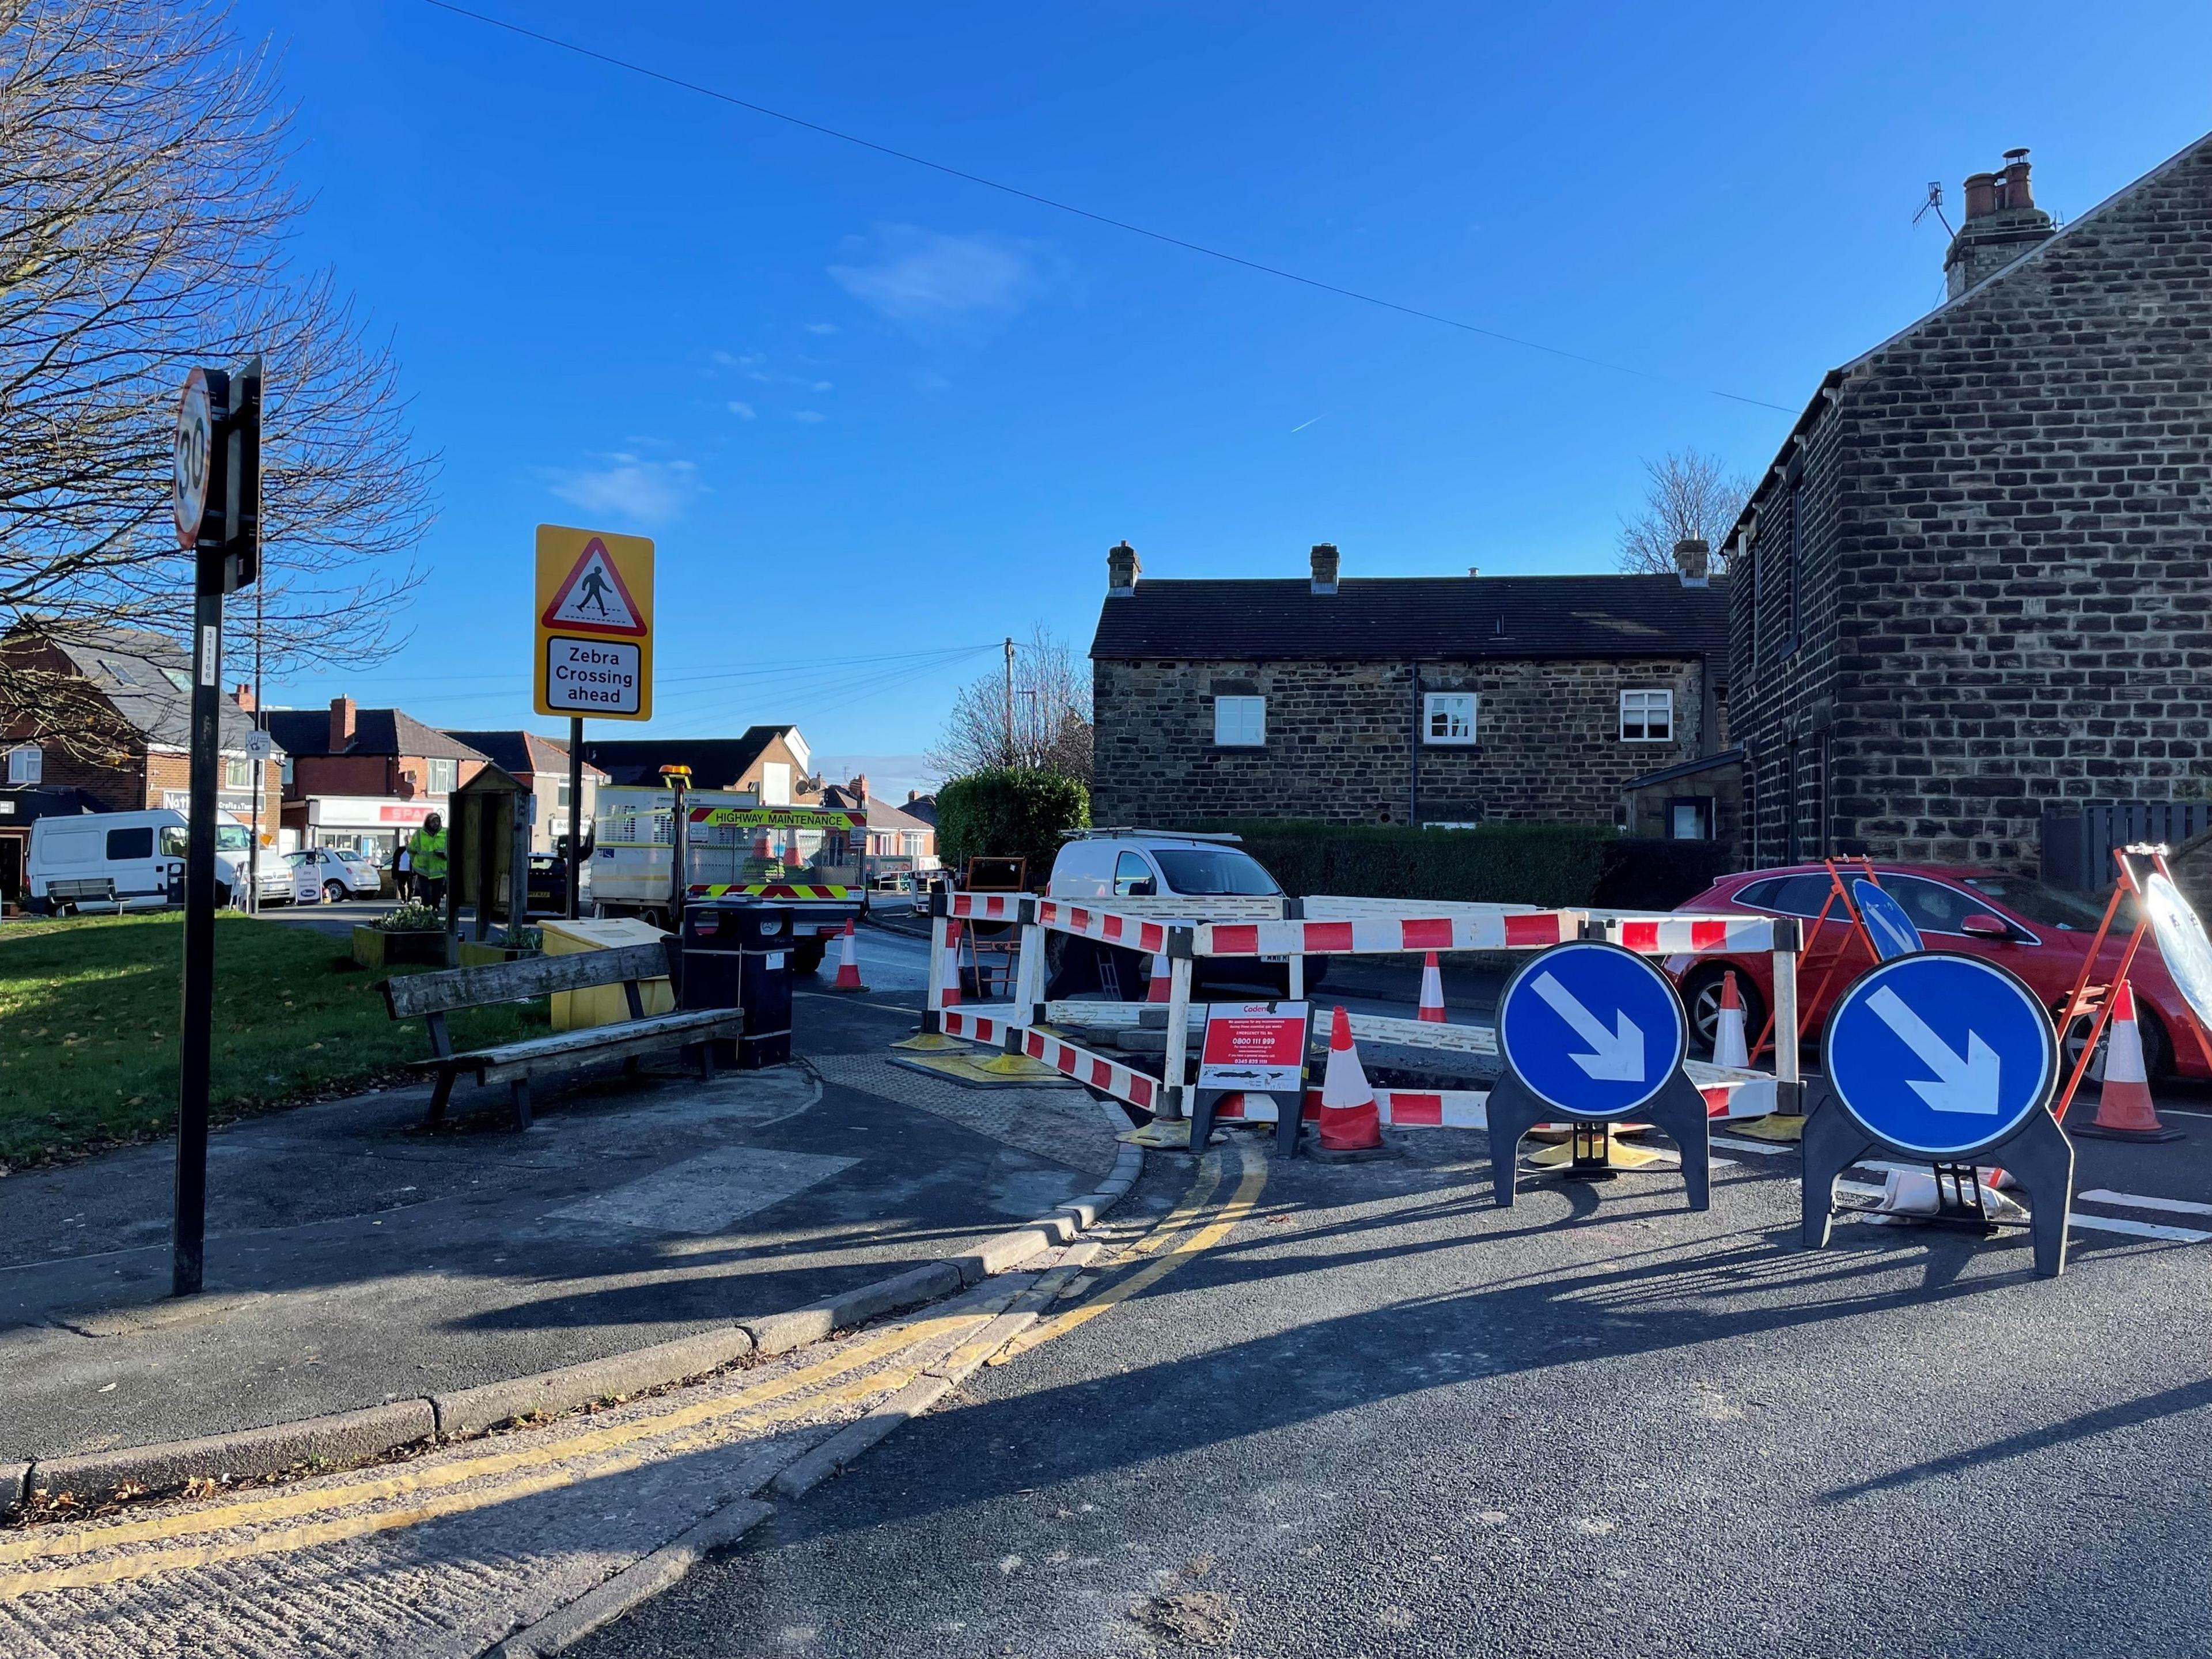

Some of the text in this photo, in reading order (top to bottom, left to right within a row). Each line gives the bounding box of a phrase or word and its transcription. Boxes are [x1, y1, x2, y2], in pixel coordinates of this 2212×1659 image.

[179, 417, 204, 499] 30
[569, 647, 619, 665] Zebra
[556, 665, 632, 687] Crossing
[567, 686, 620, 703] ahead
[716, 813, 843, 825] HIGHWAY MAINTENANCE
